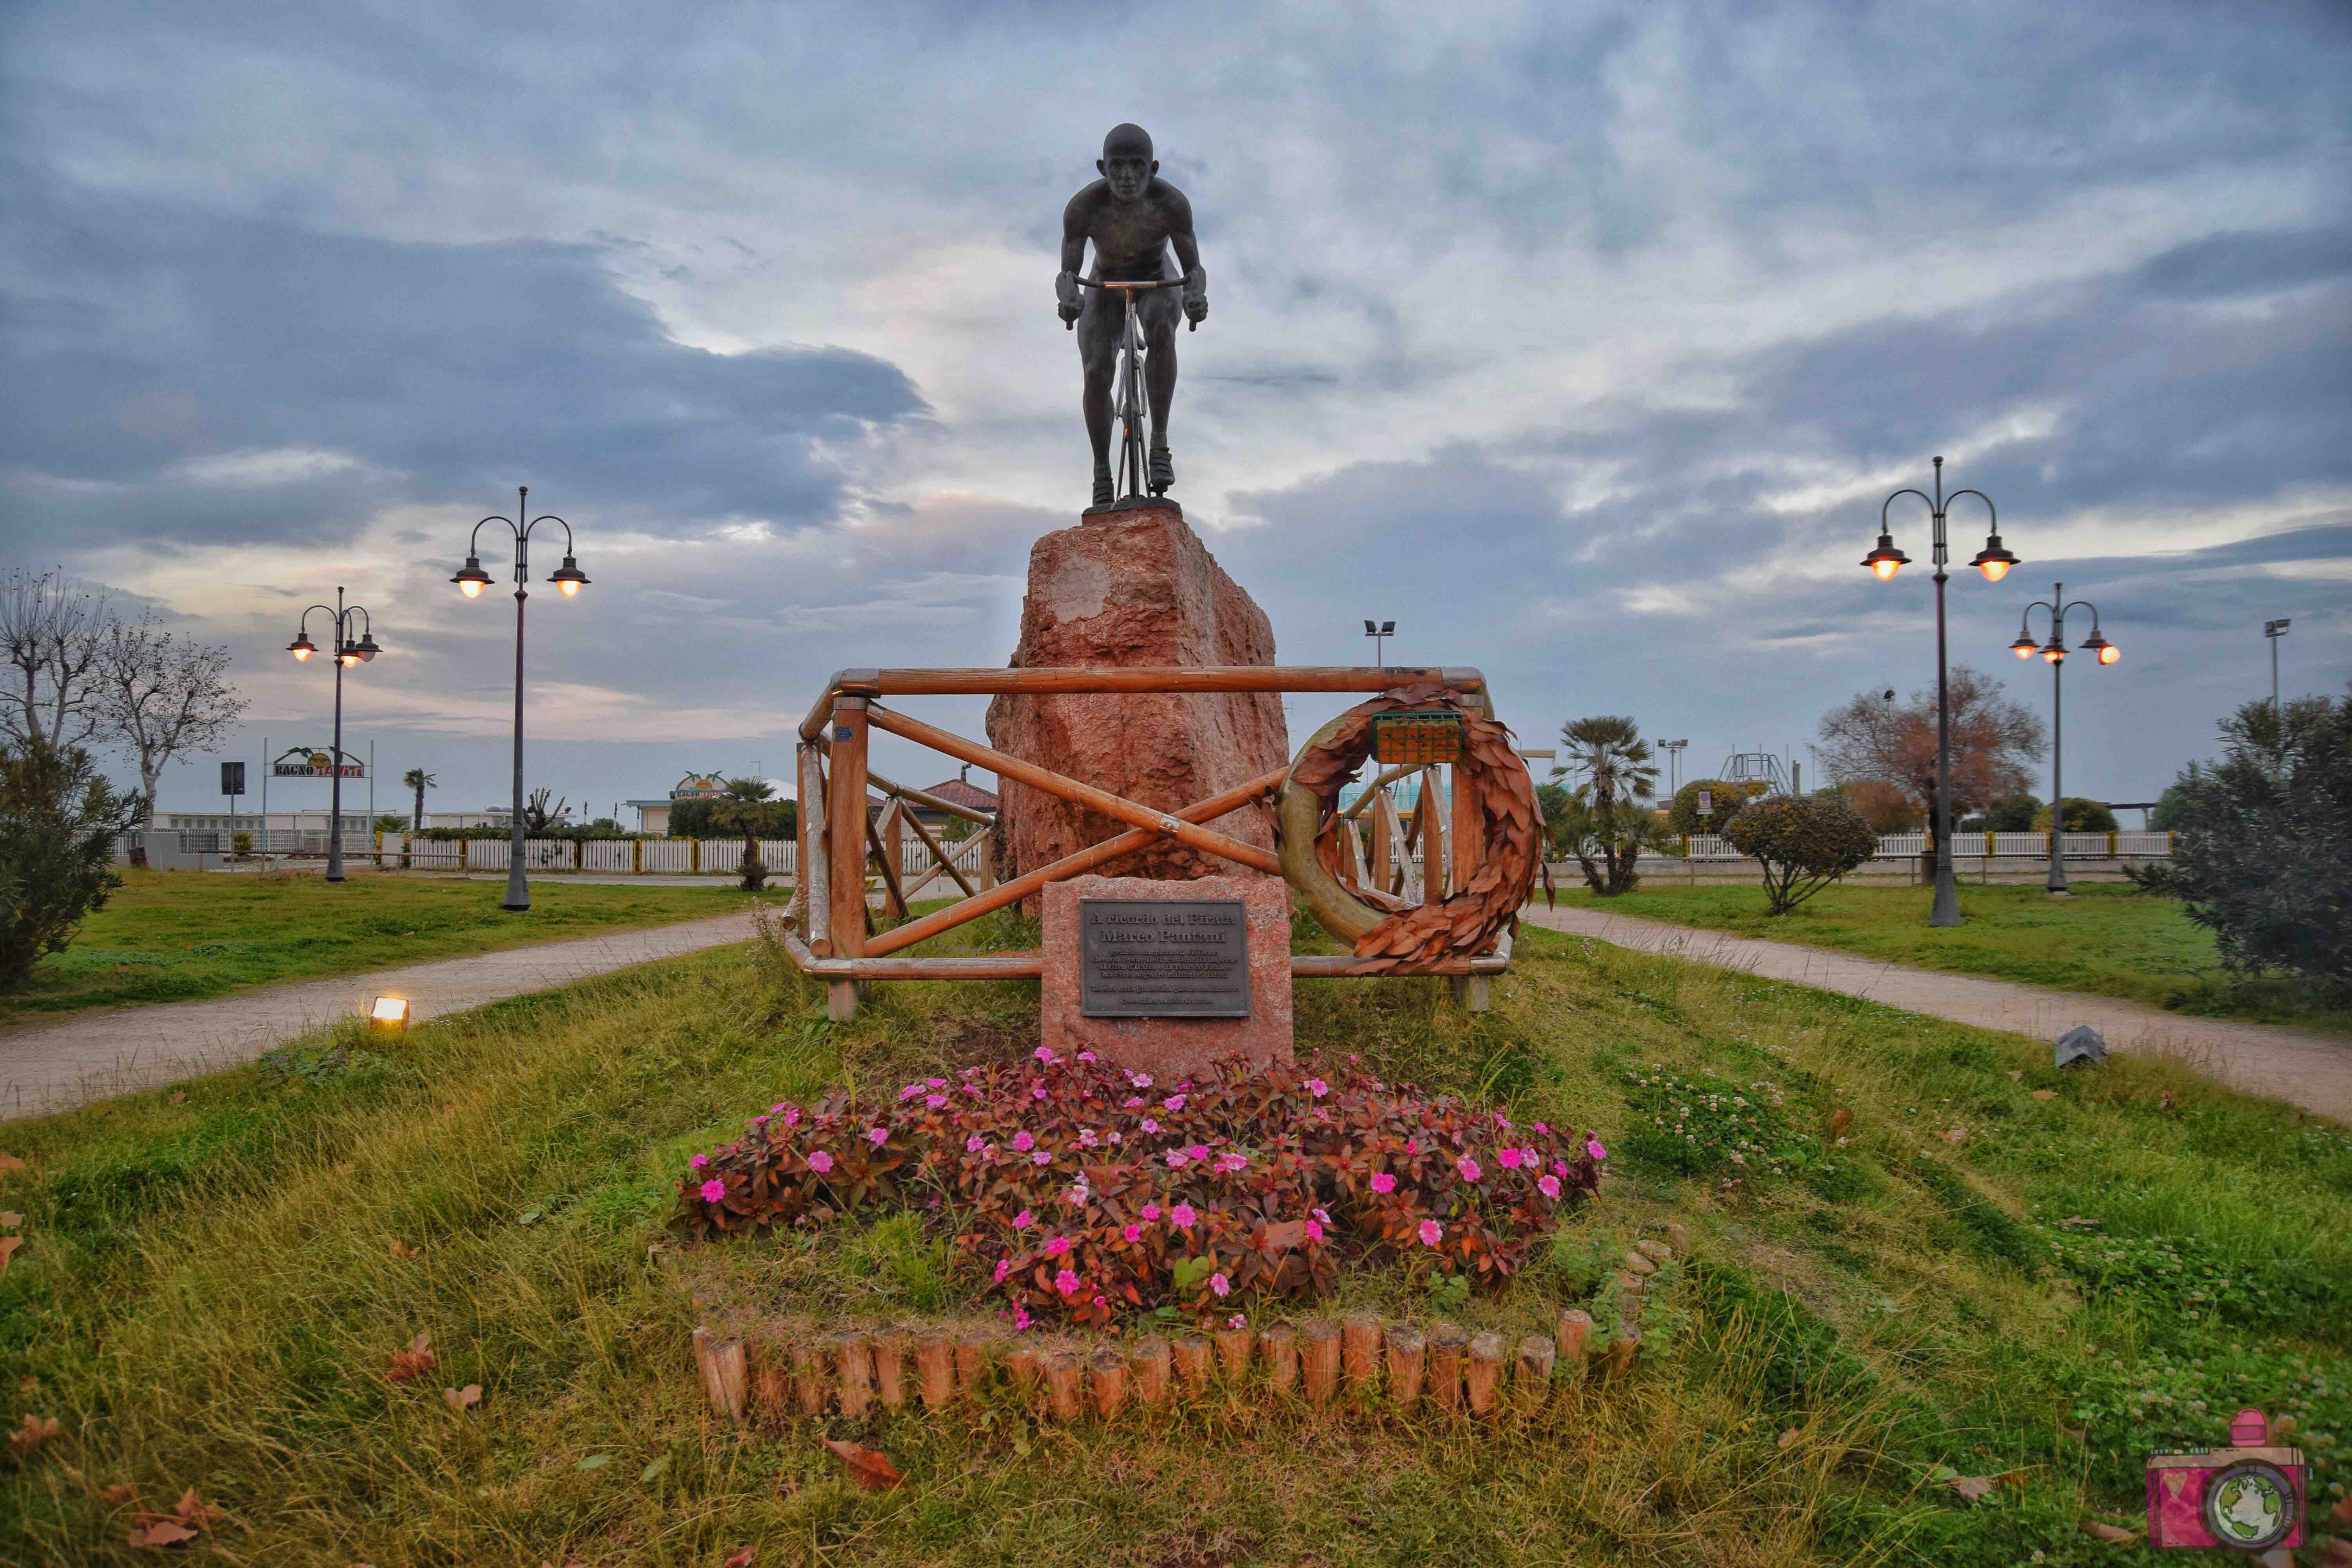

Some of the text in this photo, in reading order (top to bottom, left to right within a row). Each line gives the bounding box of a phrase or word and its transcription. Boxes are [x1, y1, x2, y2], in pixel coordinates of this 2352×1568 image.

[275, 765, 314, 775] BAGNO
[1091, 913, 1236, 925] A ricordo del Pirata
[1100, 929, 1227, 943] Marco Pantani
